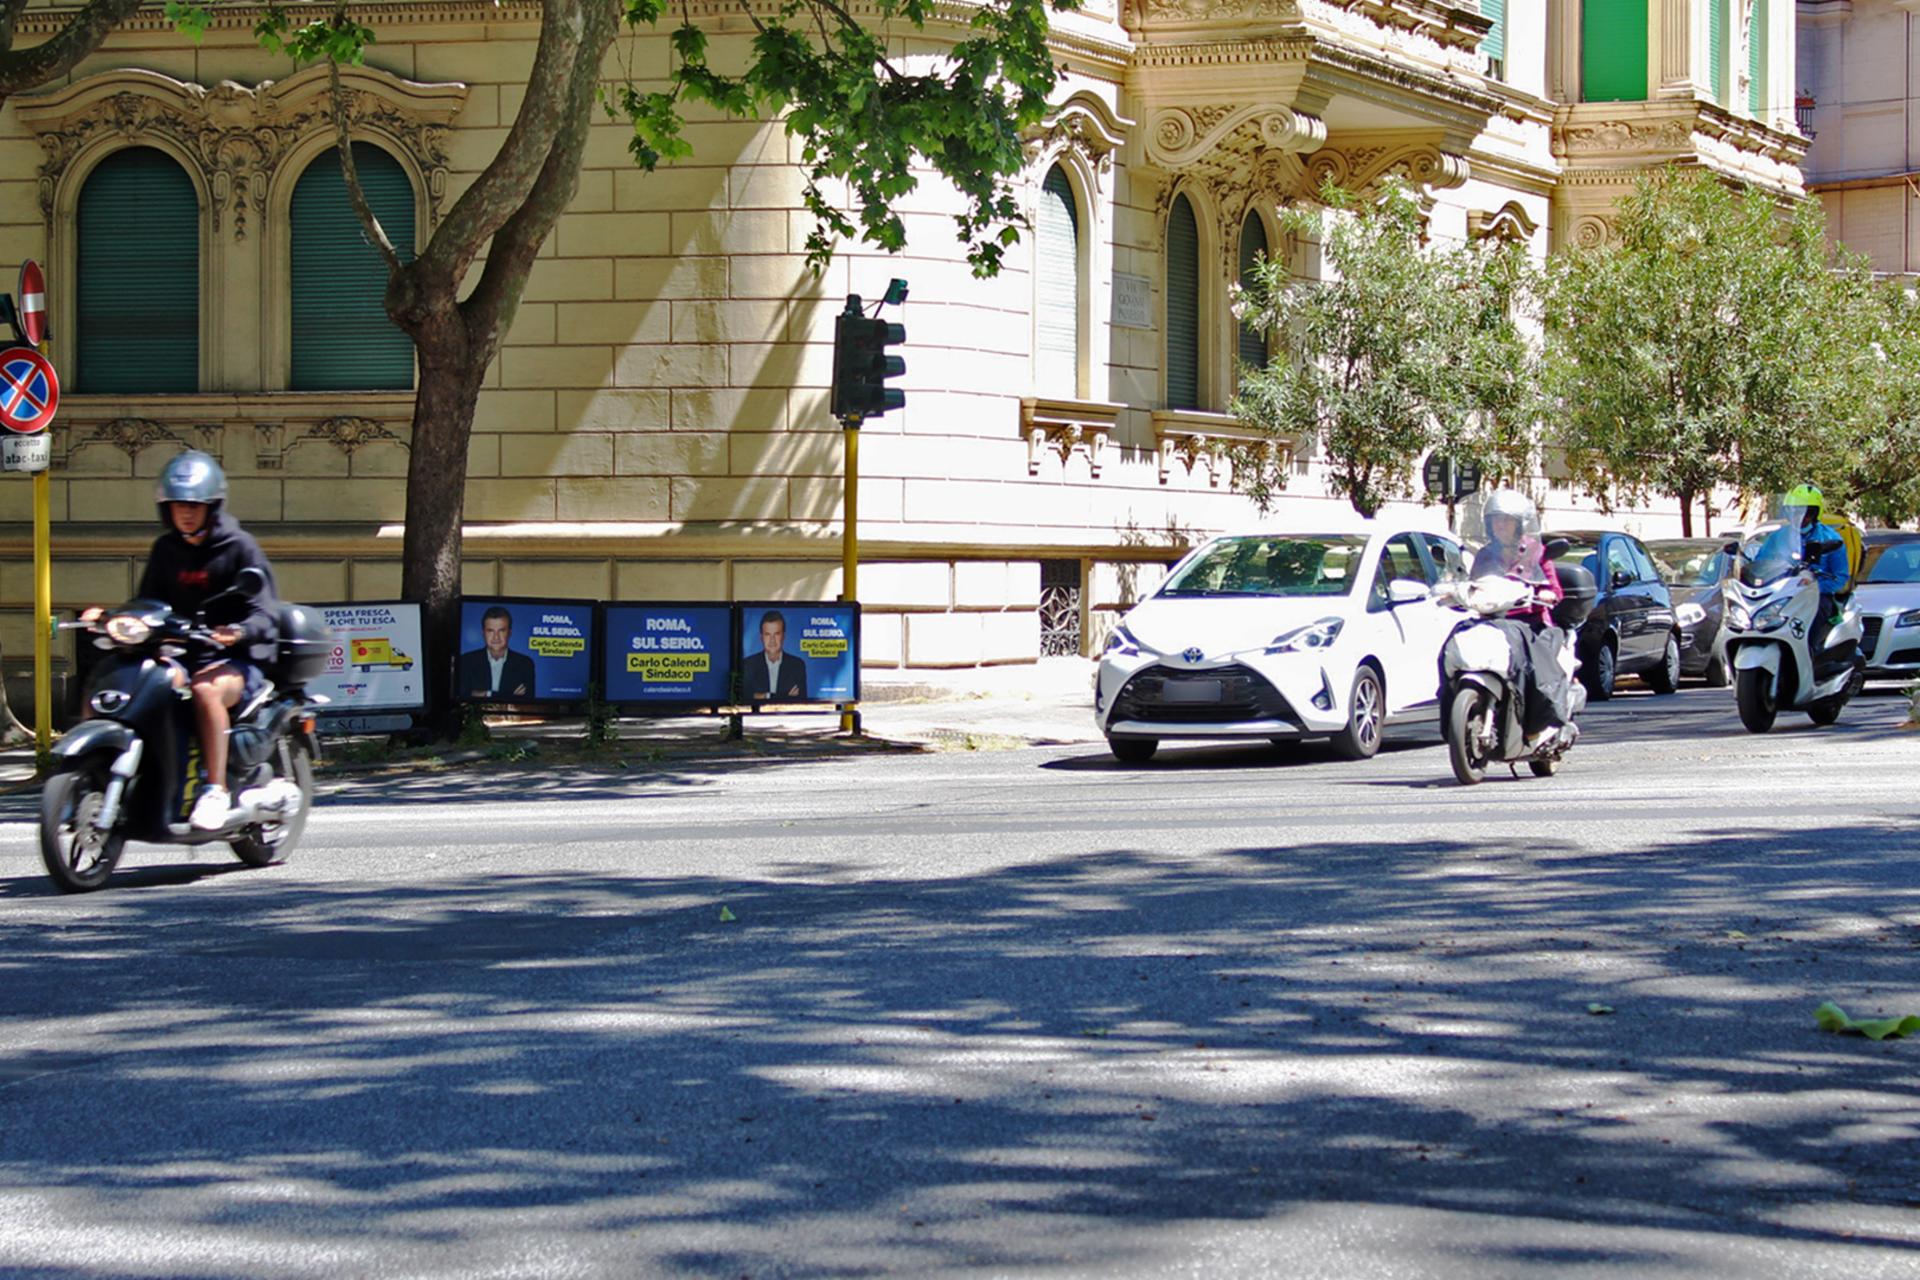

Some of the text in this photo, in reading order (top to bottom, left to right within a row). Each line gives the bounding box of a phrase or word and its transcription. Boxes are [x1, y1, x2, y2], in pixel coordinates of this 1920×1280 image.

[14, 439, 40, 448] eccetto
[5, 451, 48, 464] atac-taxi
[324, 609, 391, 618] SPESA FRESCA
[337, 618, 356, 626] CHE
[358, 617, 371, 625] TU
[372, 617, 396, 625] ESCA
[542, 614, 573, 626] ROMA,
[811, 617, 838, 627] ROMA,
[646, 618, 692, 634] ROMA,
[533, 626, 582, 637] SUL SERIO.
[803, 628, 819, 638] SUL
[531, 639, 583, 649] Carlo Calenda
[632, 636, 705, 650] SUL SERIO.
[542, 647, 572, 655] Sindaco
[630, 657, 707, 668] Carlo Calenda
[646, 668, 691, 679] Sindaco
